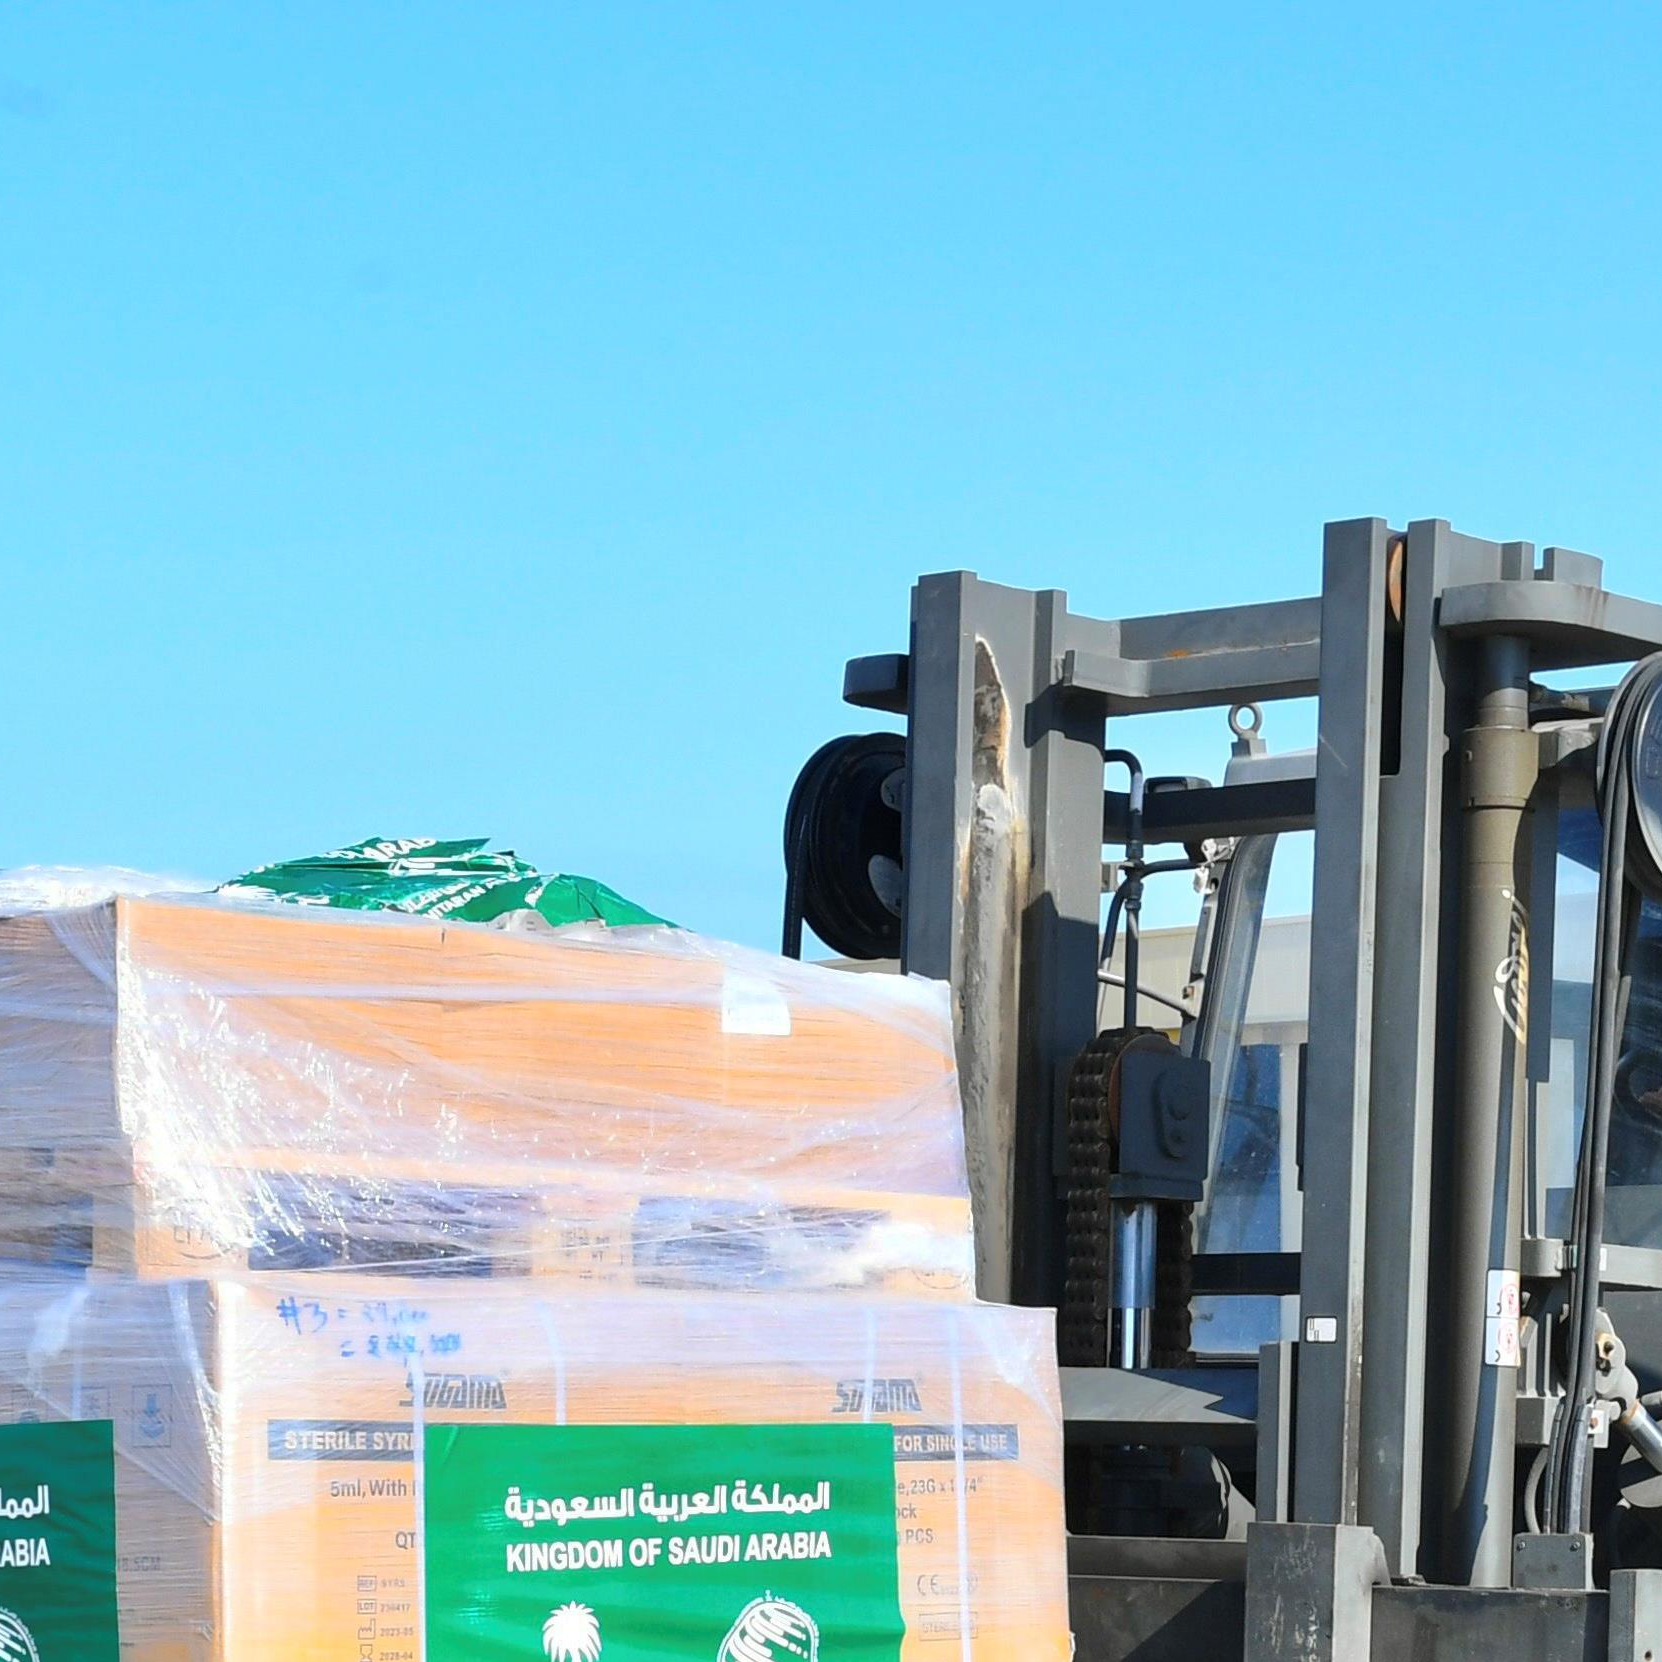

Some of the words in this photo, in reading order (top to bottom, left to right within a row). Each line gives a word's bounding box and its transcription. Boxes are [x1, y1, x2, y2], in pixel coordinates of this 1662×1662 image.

[284, 1430, 367, 1450] STERILE
[894, 1435, 923, 1452] FOR
[980, 1434, 1007, 1450] USE
[504, 1487, 635, 1528] السعودية
[639, 1482, 727, 1523] العربية
[731, 1480, 830, 1514] المملكة
[506, 1539, 623, 1572] KINGDOM
[629, 1538, 662, 1567] OF
[668, 1535, 739, 1565] SAUDI
[744, 1531, 832, 1561] ARABIA
[906, 1529, 933, 1544] PCS
[359, 1602, 375, 1611] LOT
